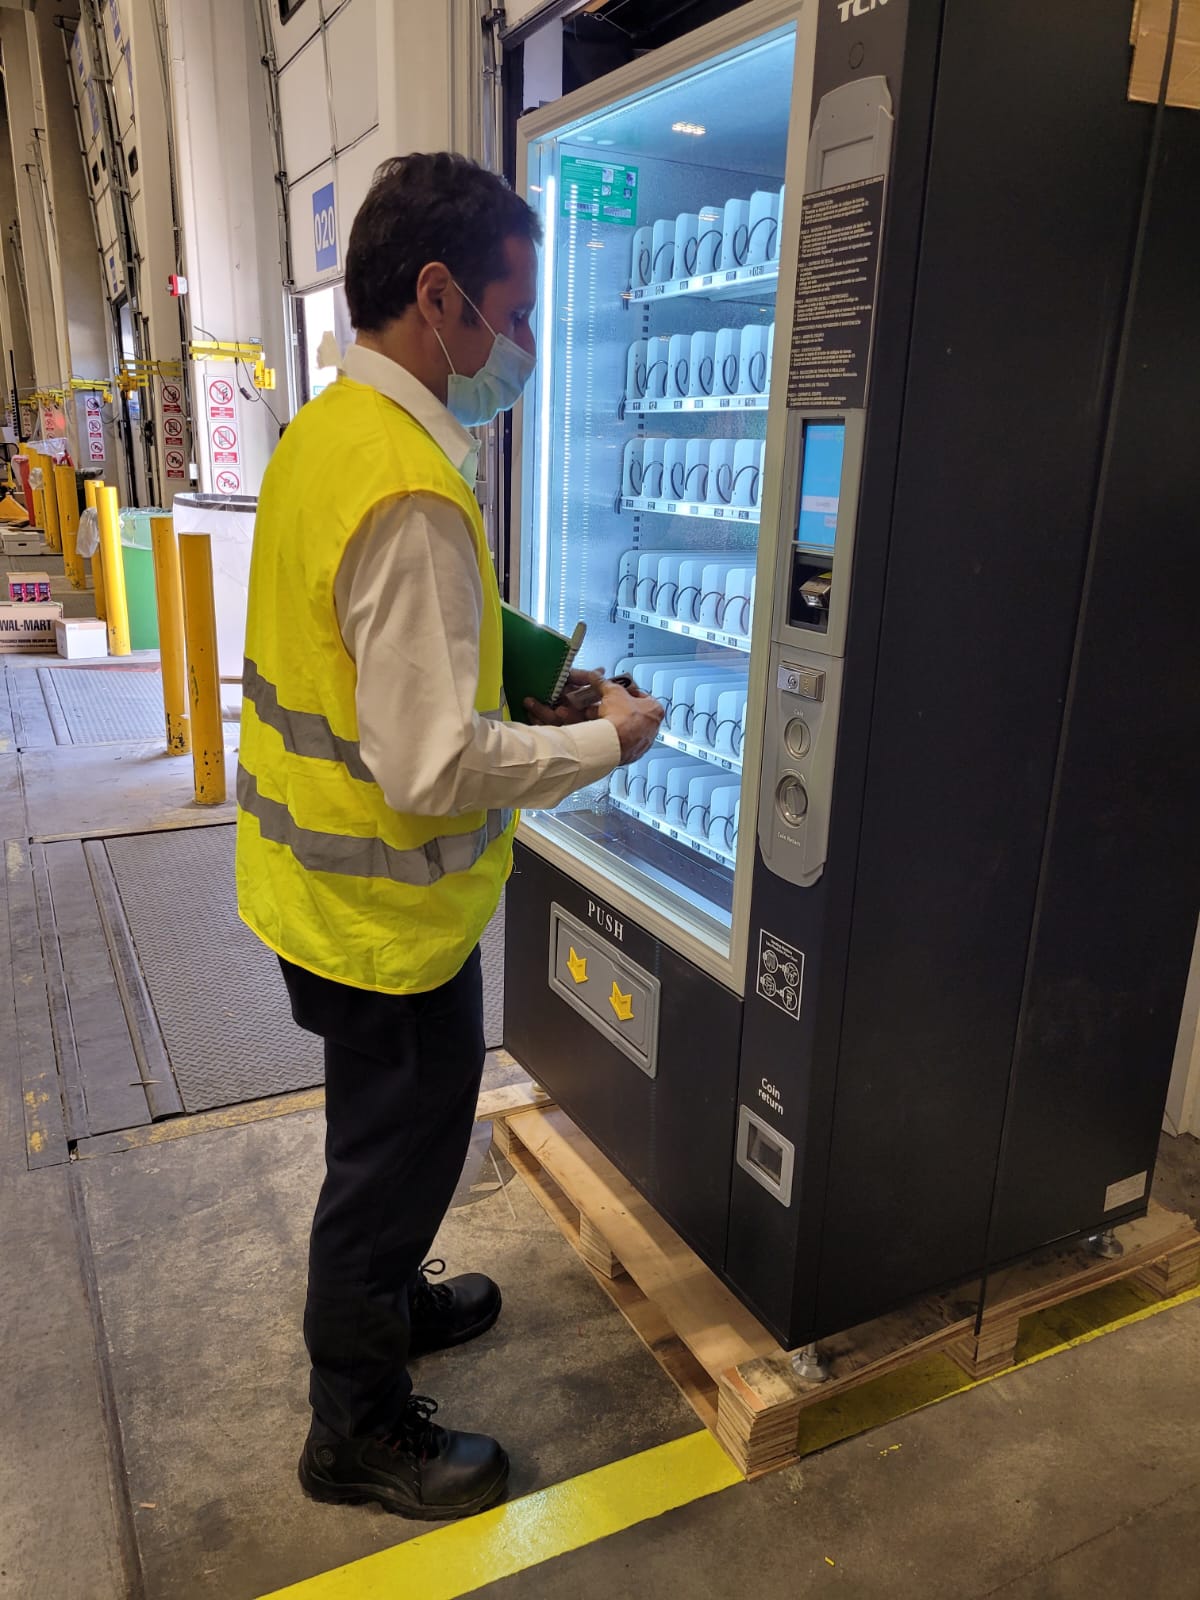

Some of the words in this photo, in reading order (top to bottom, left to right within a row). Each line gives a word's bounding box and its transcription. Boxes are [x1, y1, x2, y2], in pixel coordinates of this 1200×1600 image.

[314, 206, 335, 252] 020
[0, 619, 52, 631] WAL-MART
[588, 900, 624, 942] PUSH
[758, 1089, 784, 1115] return
[761, 1078, 781, 1100] Coin
